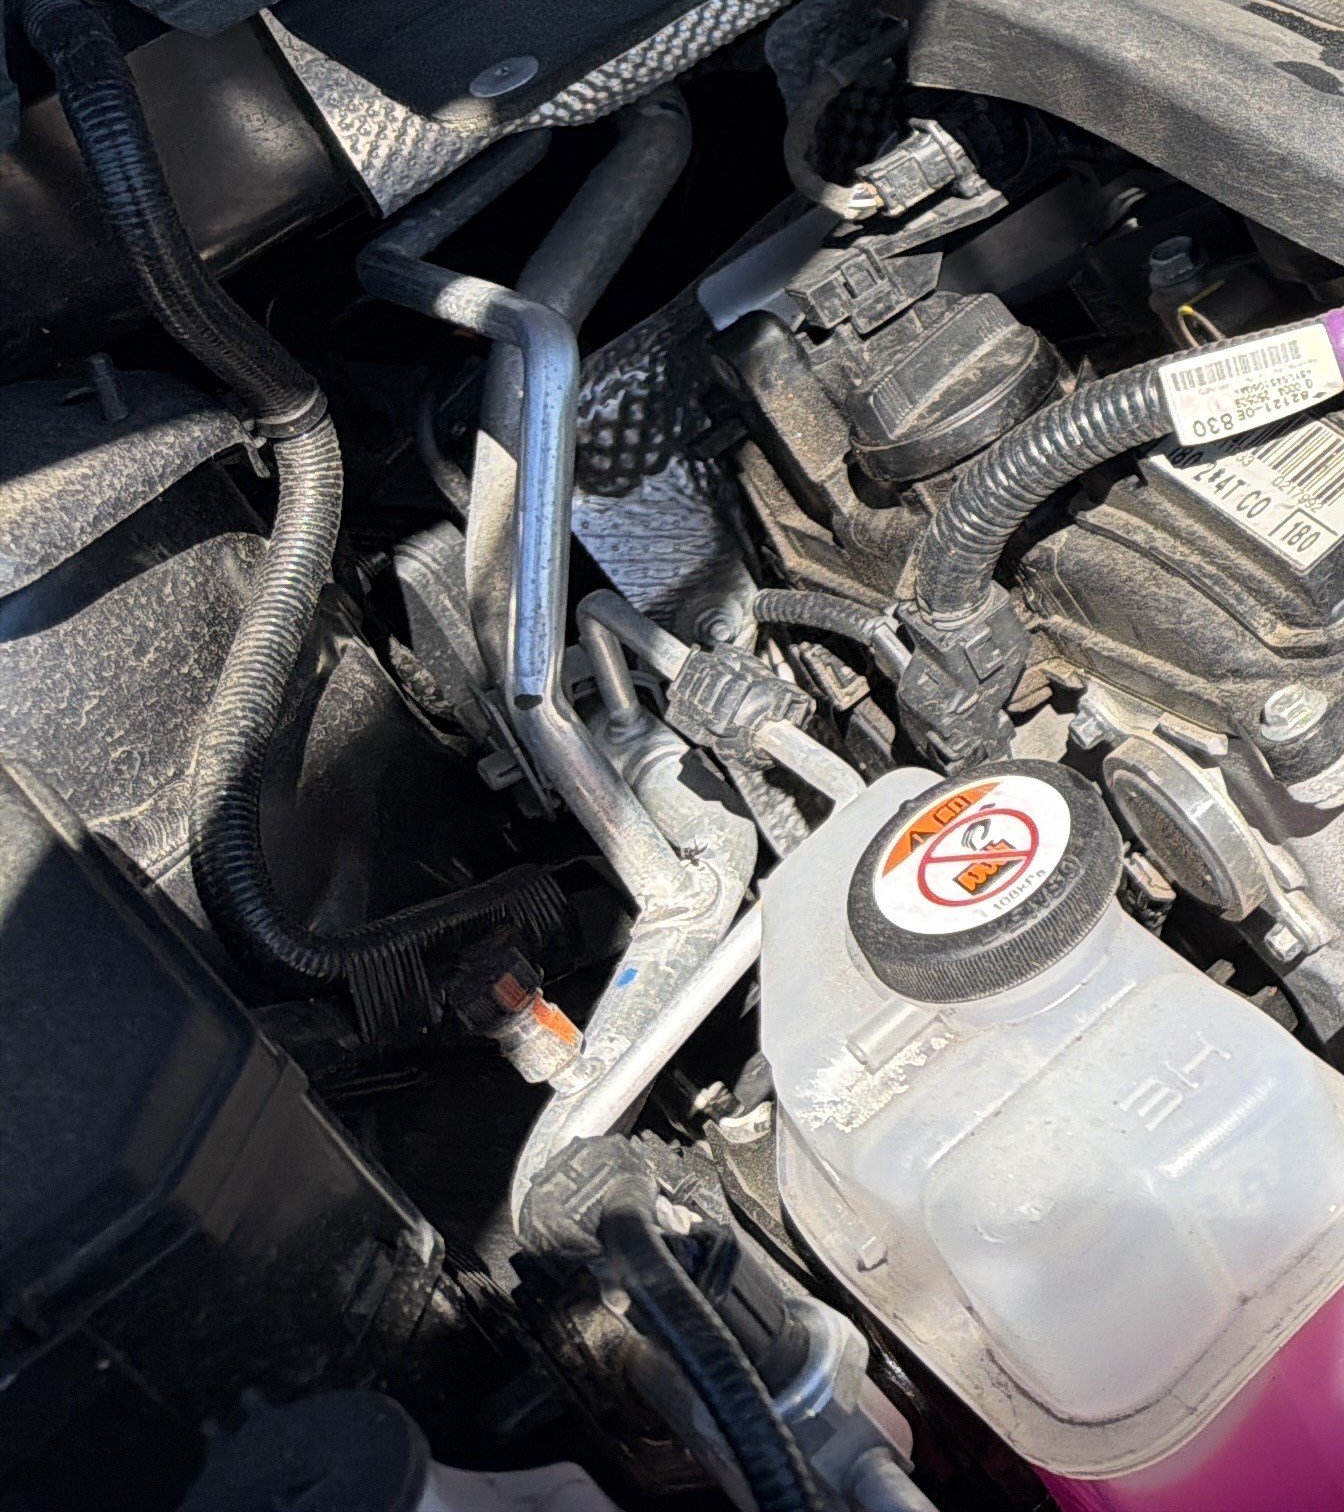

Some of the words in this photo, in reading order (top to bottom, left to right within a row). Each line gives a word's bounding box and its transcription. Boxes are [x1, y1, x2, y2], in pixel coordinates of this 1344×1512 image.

[1236, 390, 1309, 421] 82121-0E
[1193, 413, 1235, 438] 830
[1280, 521, 1322, 553] 180
